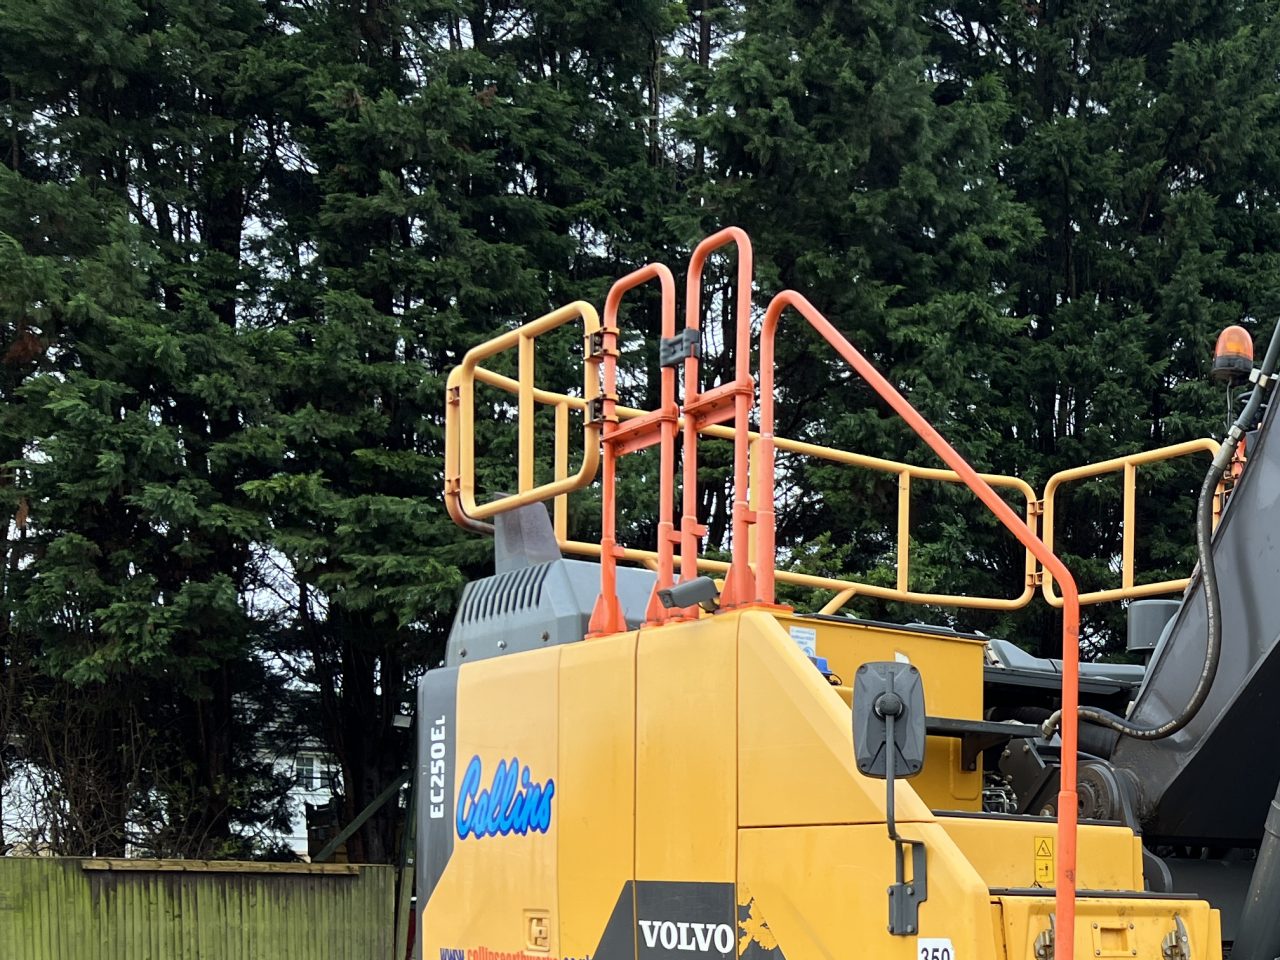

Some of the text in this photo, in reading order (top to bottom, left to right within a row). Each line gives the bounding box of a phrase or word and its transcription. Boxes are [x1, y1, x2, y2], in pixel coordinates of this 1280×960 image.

[429, 714, 446, 819] EC250EL
[456, 755, 554, 840] Collins
[638, 920, 735, 954] VOLVO
